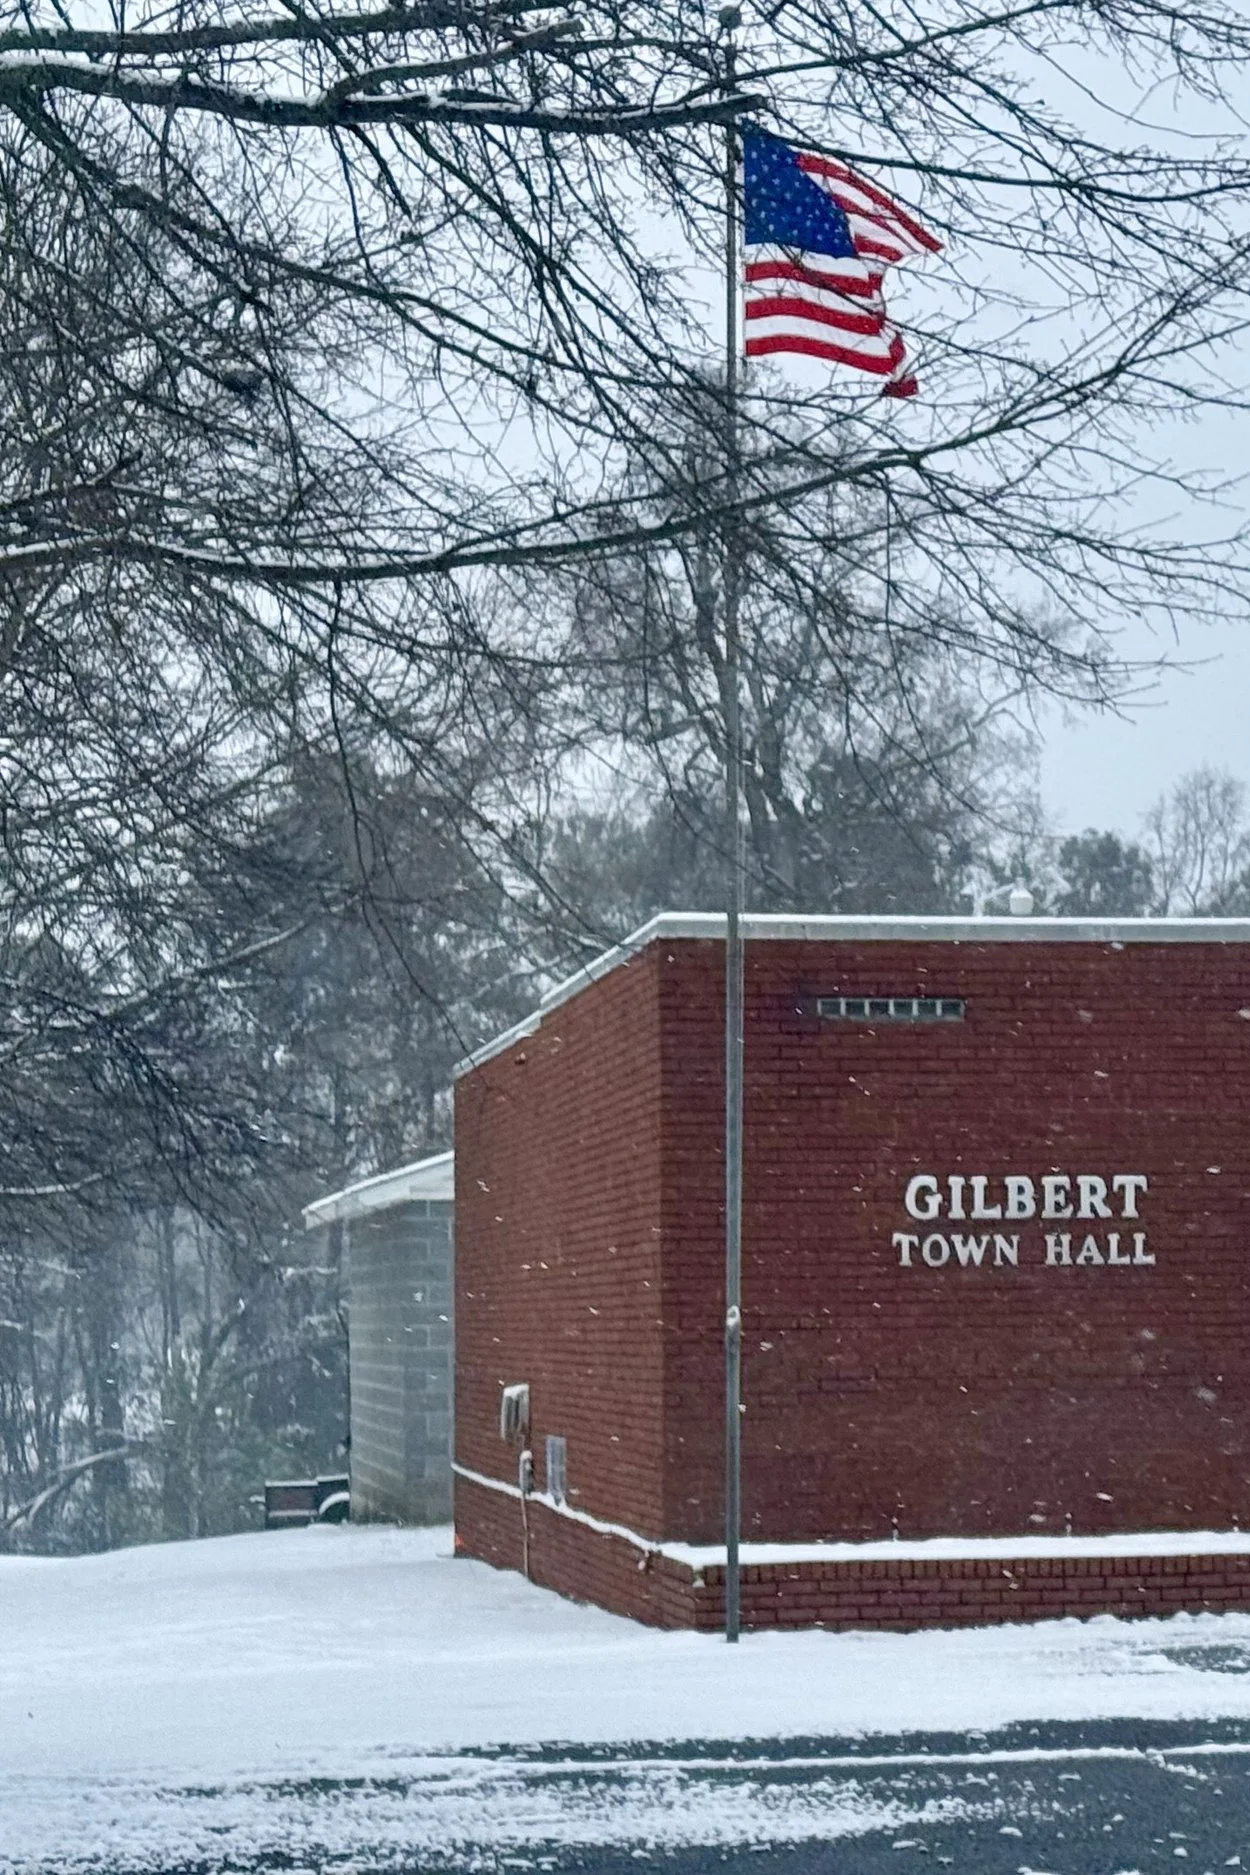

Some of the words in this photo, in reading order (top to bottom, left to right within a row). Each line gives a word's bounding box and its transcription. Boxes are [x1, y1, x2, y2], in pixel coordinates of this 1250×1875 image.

[904, 1174, 1148, 1220] GILBERT
[892, 1232, 1020, 1267] TOWN
[1044, 1232, 1156, 1266] HALL
